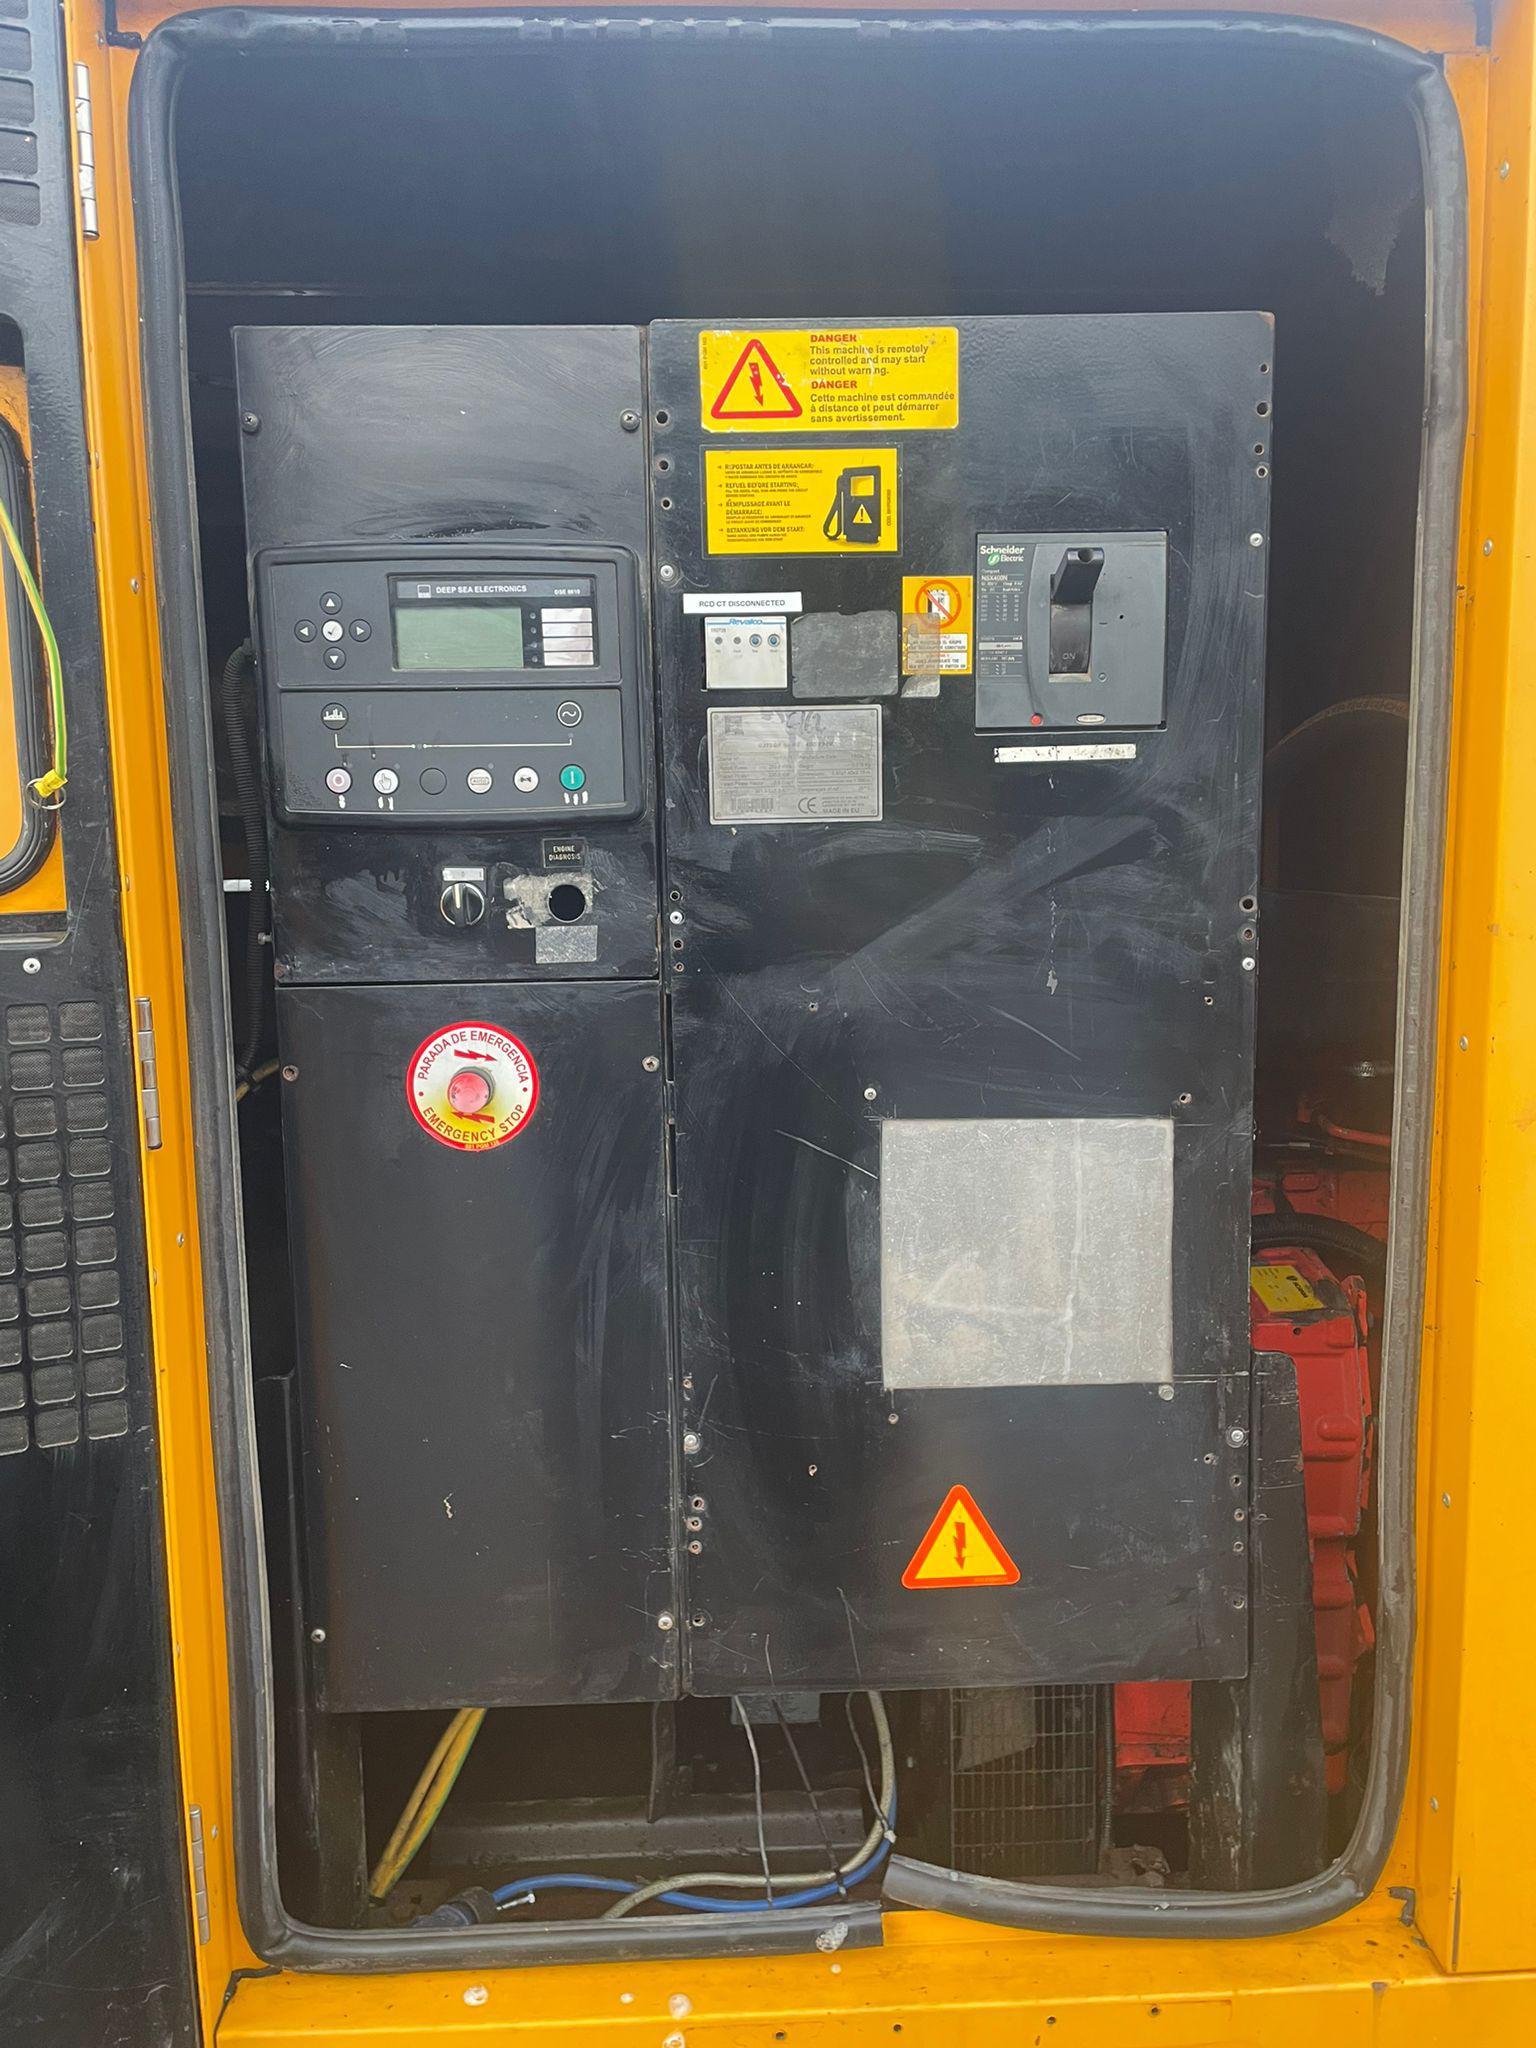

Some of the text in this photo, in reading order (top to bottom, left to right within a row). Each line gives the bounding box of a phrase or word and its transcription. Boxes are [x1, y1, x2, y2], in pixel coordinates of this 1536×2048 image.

[810, 334, 857, 343] DANGER
[810, 344, 928, 355] This machine is remotely
[810, 355, 926, 366] controlled and may start
[810, 366, 889, 376] without warnng.
[811, 380, 858, 389] DANGER
[810, 391, 954, 402] Cette machine est commandée
[810, 402, 940, 413] à distance et peut démarrer
[810, 413, 904, 423] sans avertissement.
[980, 545, 1025, 555] Schneider
[1000, 554, 1024, 562] Electric
[436, 586, 456, 594] DEEP
[474, 585, 527, 593] ELECTRONICS
[553, 845, 575, 853] ENGINE
[548, 853, 581, 861] DIAGNOSIS
[418, 1030, 529, 1083] PARADA DE EMERGENCIA
[422, 1104, 525, 1142] EMERGENCY STOP
